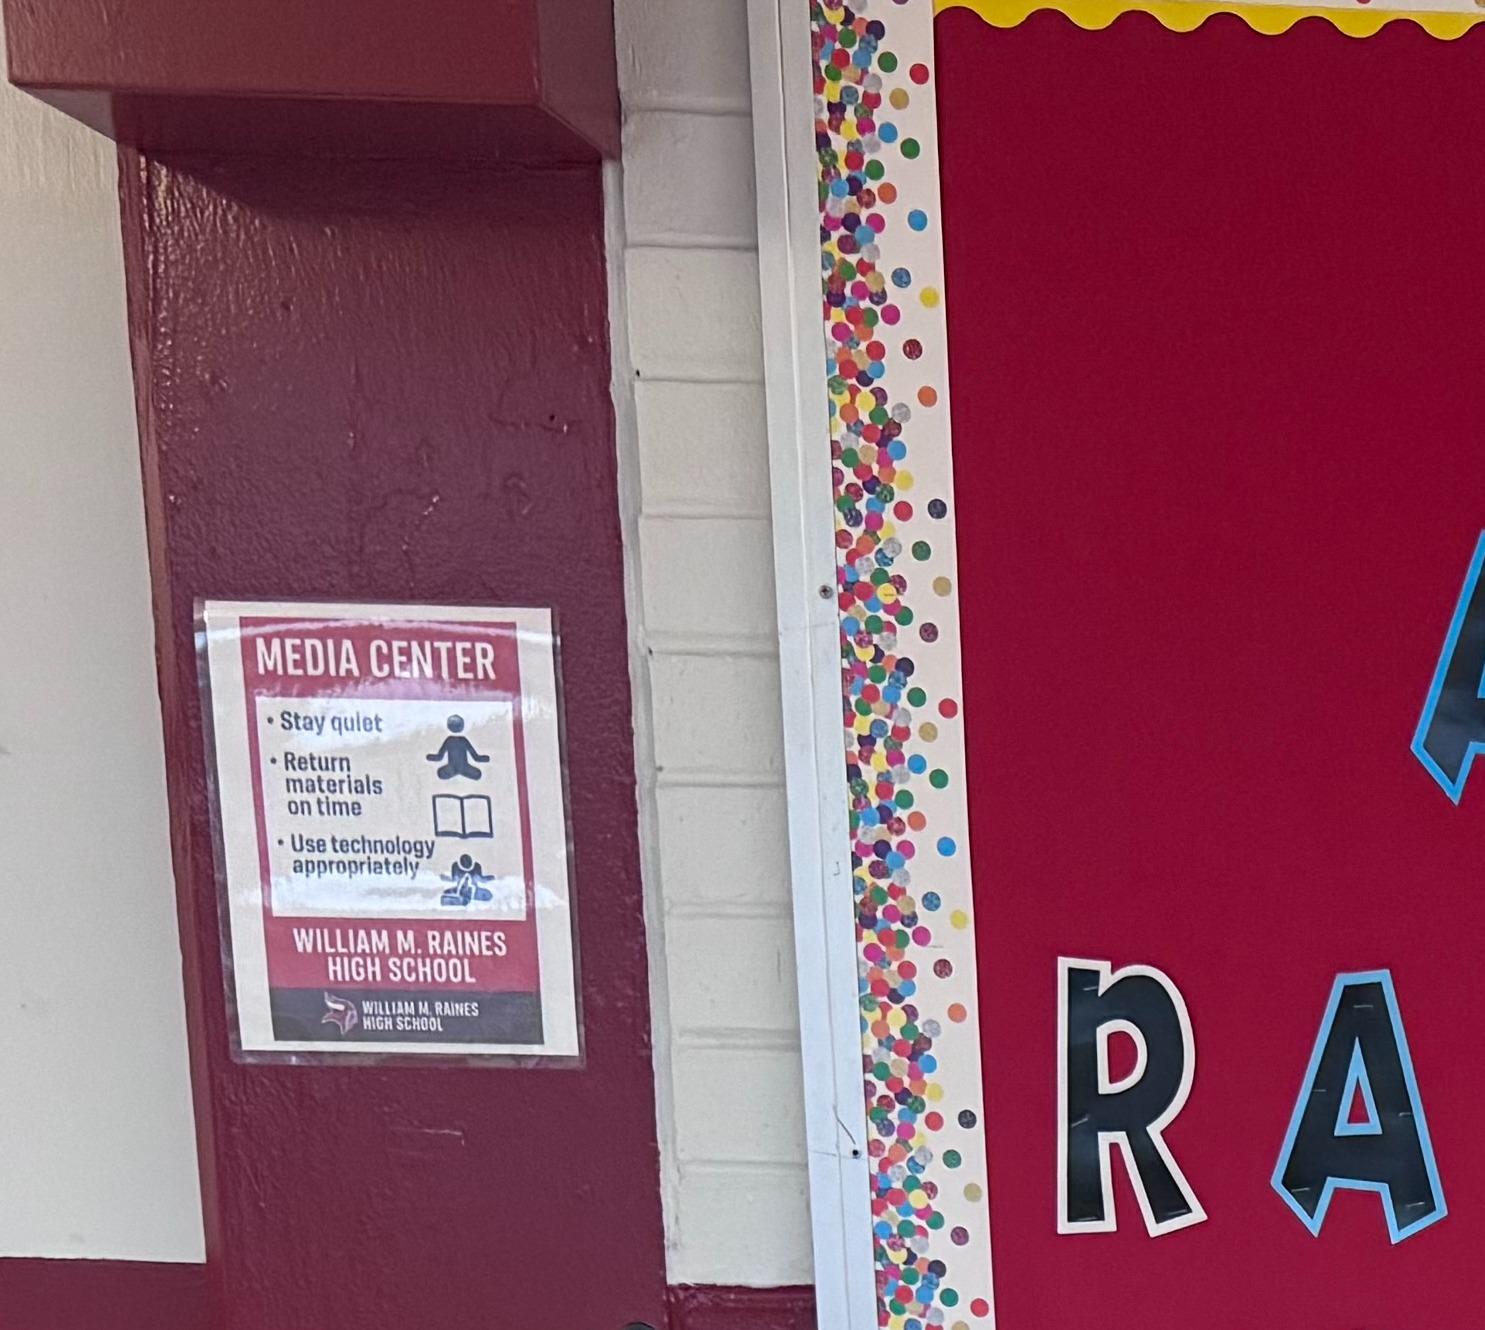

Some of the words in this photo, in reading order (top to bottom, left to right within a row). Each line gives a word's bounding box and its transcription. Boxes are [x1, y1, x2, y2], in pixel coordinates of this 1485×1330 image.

[255, 637, 360, 678] MEDIA
[369, 639, 496, 681] CENTER
[280, 711, 325, 734] Stay
[330, 713, 383, 735] quiet
[284, 752, 352, 774] Return
[285, 776, 383, 796] materials
[287, 801, 312, 817] on
[317, 798, 363, 818] time
[291, 835, 327, 854] Use
[331, 836, 436, 859] technology
[292, 858, 420, 880] appropriately
[293, 928, 391, 956] WILLIAM
[397, 931, 423, 956] M.
[428, 931, 508, 957] RAINES
[327, 956, 382, 983] HIGH
[388, 957, 477, 984] SCHOOL
[362, 999, 417, 1018] WILLIAM
[419, 1001, 433, 1018] M.
[435, 1001, 480, 1018] RAINES
[363, 1014, 393, 1032] HIGH
[396, 1016, 444, 1032] SCHOOL
